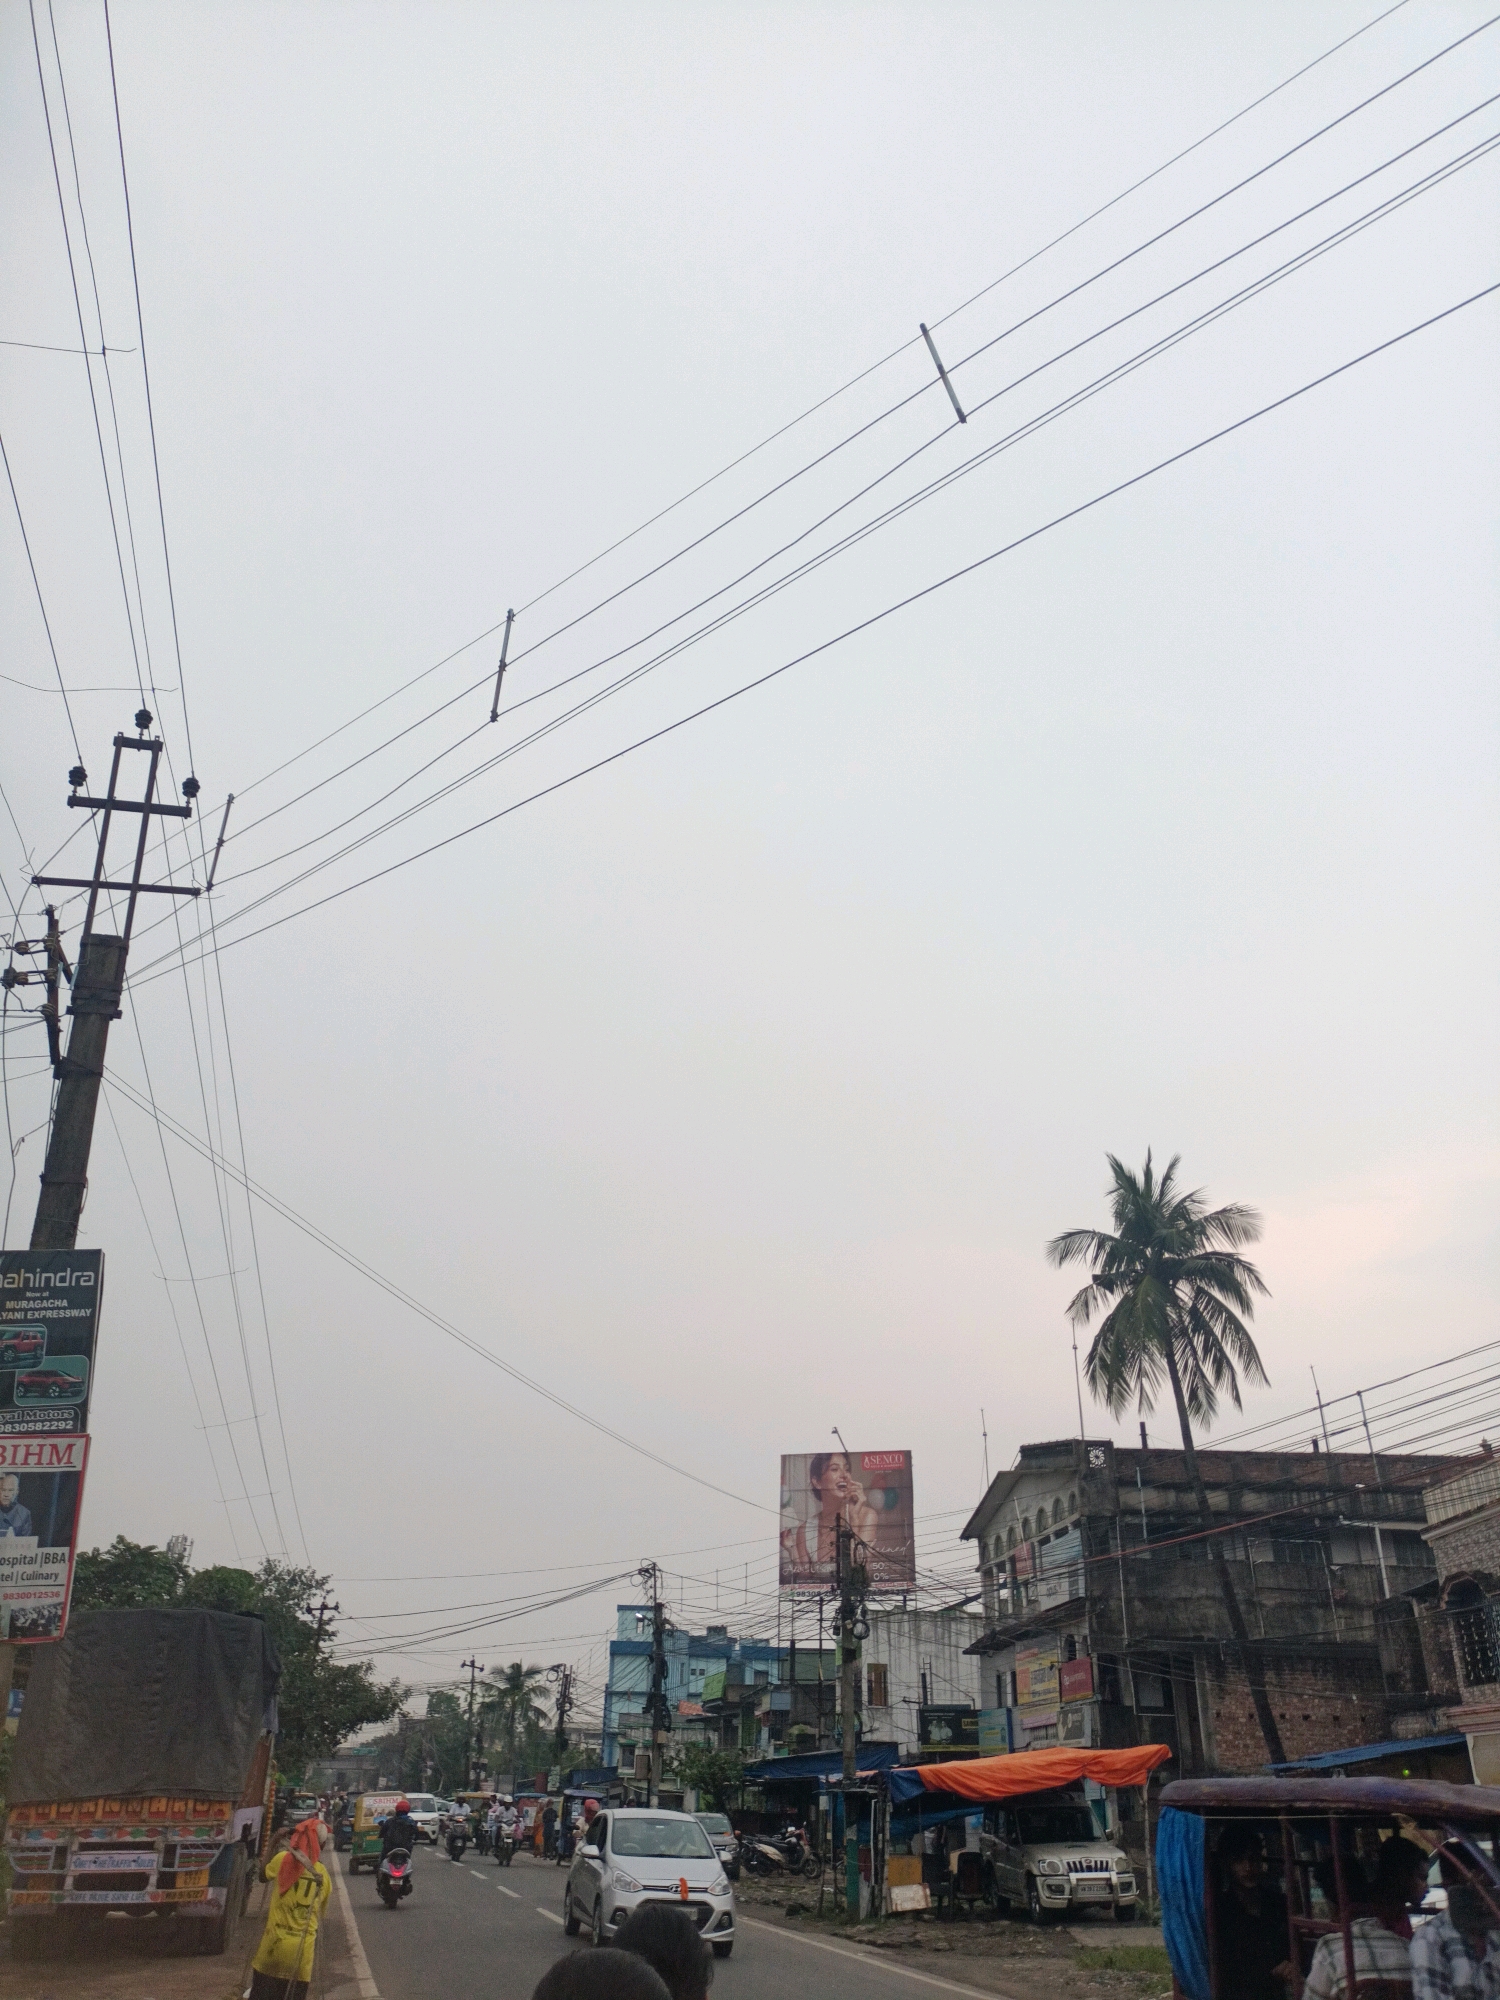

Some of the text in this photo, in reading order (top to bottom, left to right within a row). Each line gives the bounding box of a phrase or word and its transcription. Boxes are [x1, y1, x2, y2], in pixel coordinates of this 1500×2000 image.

[0, 1267, 95, 1288] ahindra
[5, 1300, 68, 1309] MURAGACHA
[27, 1309, 92, 1319] EXPRESSWAY
[23, 1410, 74, 1420] Motors
[21, 1571, 59, 1582] Culinary
[3, 1591, 61, 1600] 9830012536
